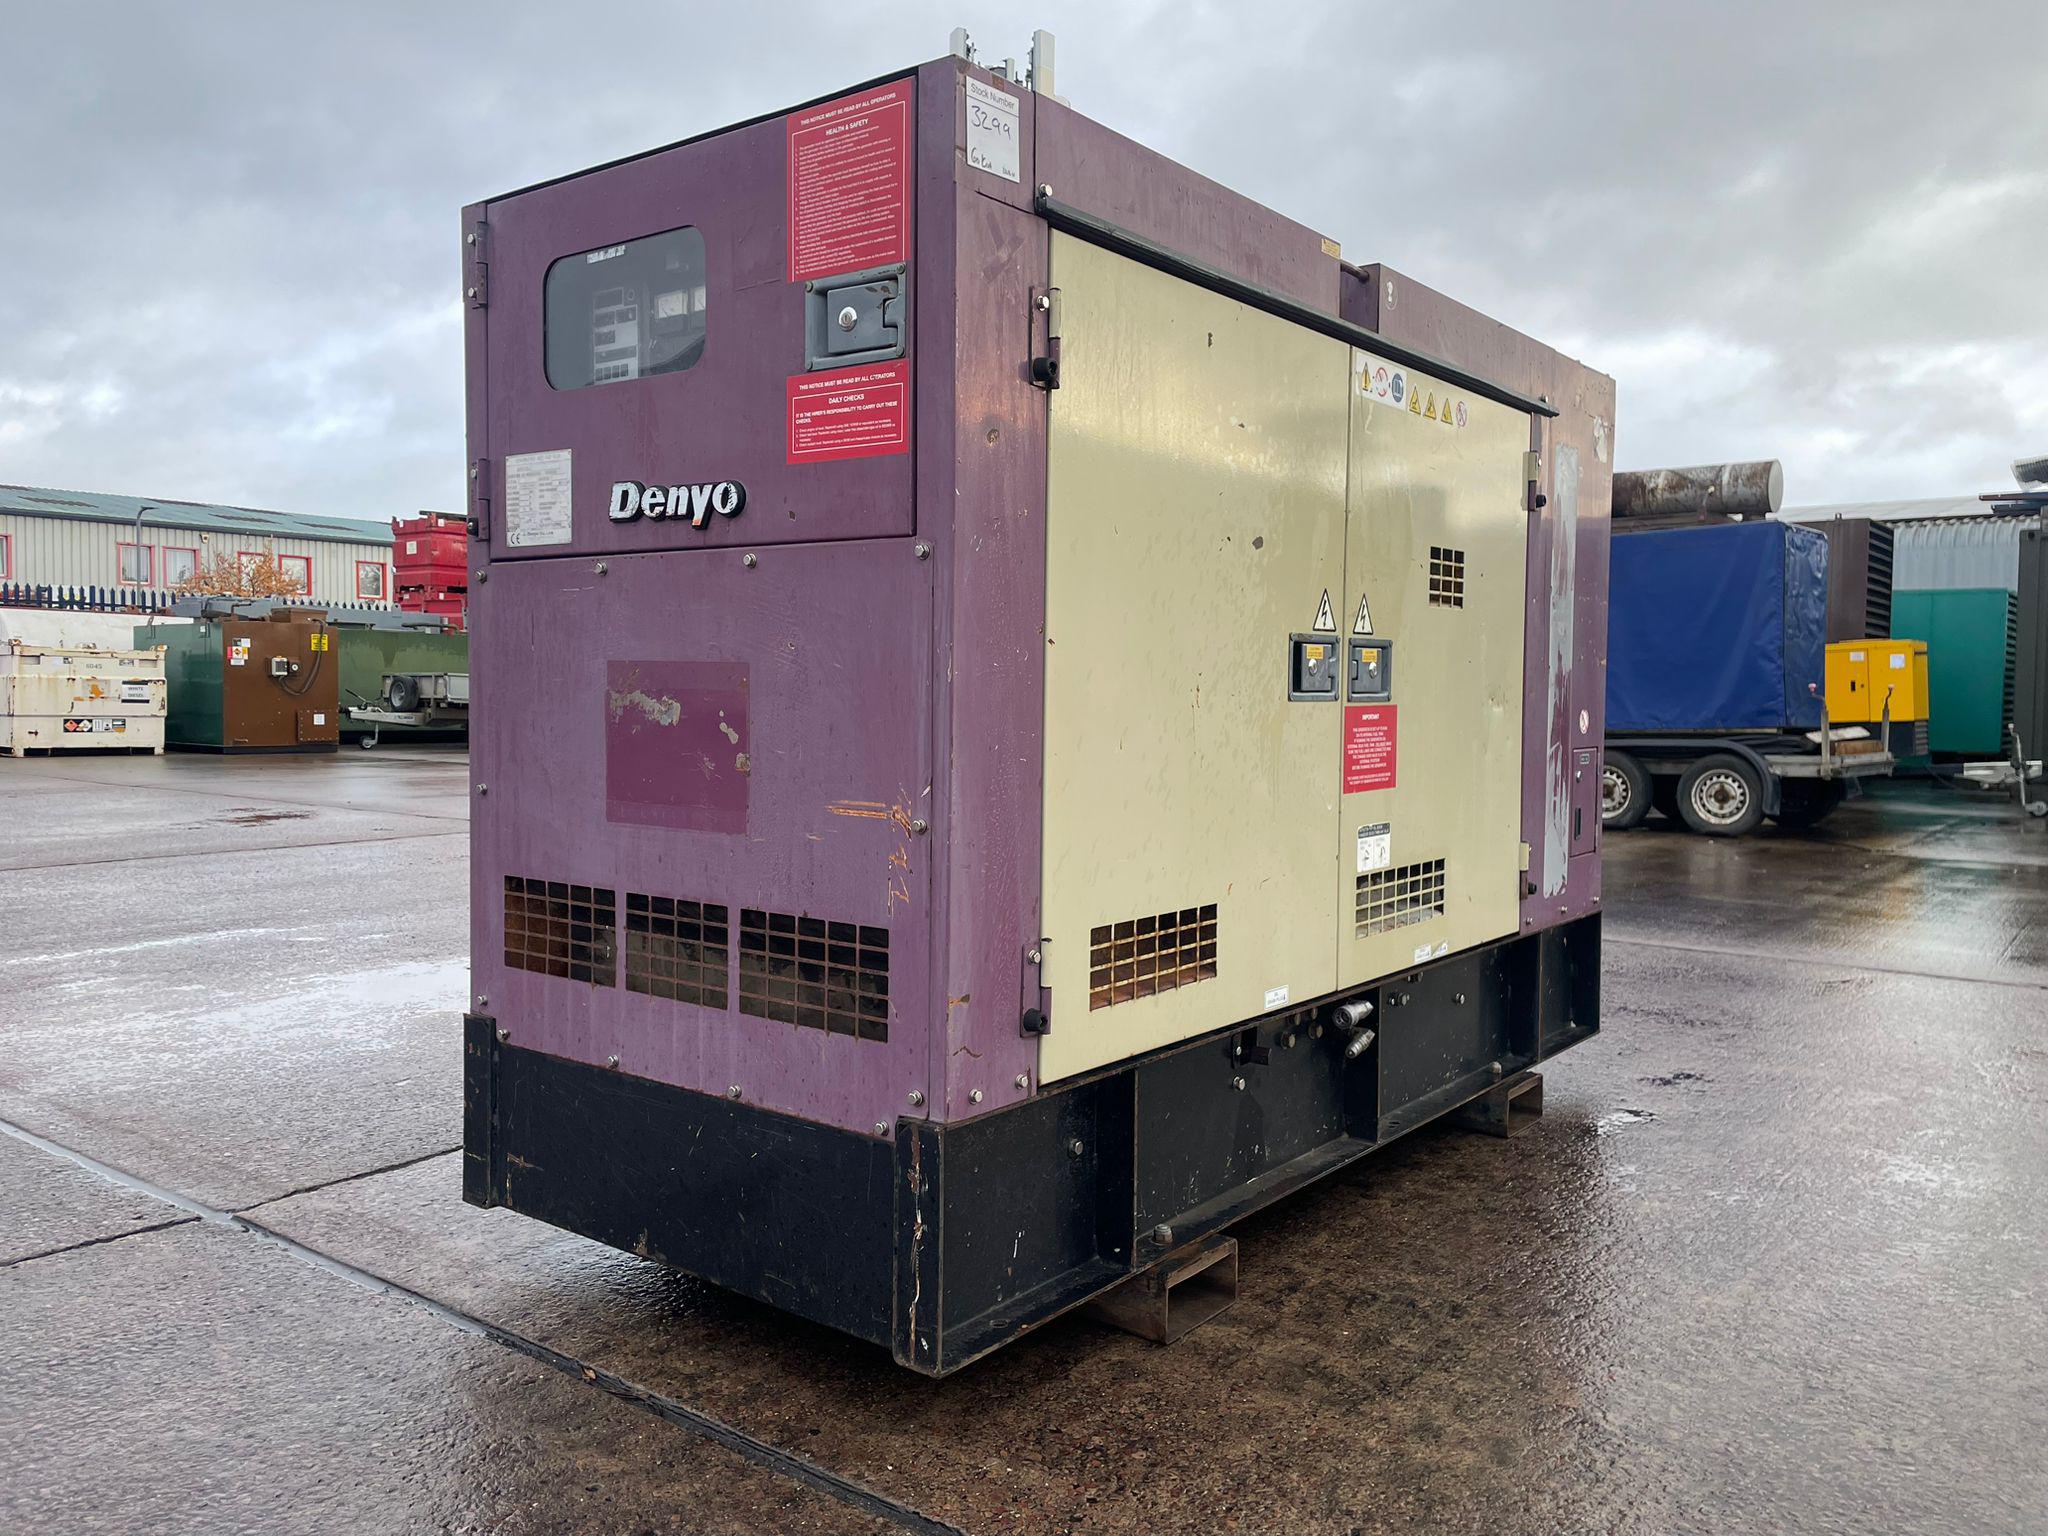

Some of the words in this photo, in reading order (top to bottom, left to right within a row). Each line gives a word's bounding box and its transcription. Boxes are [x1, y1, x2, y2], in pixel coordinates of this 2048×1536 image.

[810, 114, 825, 122] NOTICE
[870, 93, 896, 104] OPERATORS
[970, 83, 989, 99] Stock
[990, 91, 1015, 109] Number
[826, 125, 845, 135] HEALTH
[849, 118, 869, 129] SAFETY
[971, 105, 1011, 140] 3299
[843, 394, 865, 402] CHECKS
[609, 480, 745, 529] Denyo
